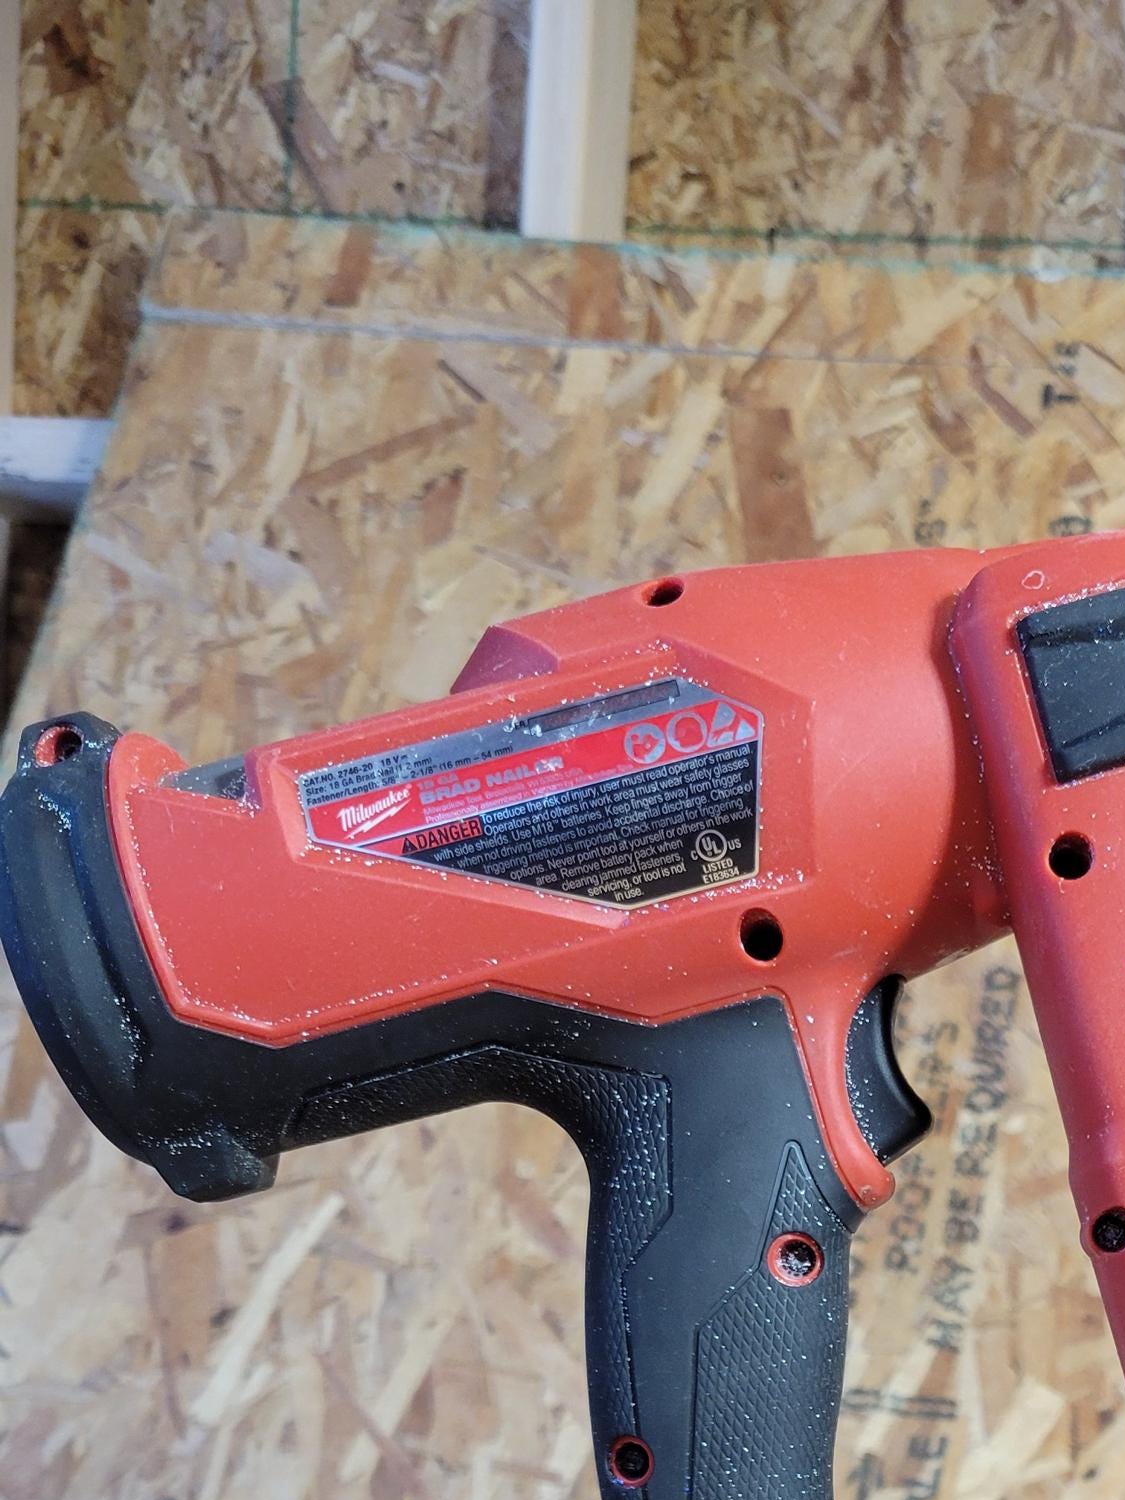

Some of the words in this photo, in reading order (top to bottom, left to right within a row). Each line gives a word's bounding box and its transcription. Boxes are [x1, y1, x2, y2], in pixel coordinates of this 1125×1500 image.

[305, 784, 327, 796] Size:
[329, 781, 340, 790] 18
[341, 777, 354, 786] GA
[395, 762, 411, 773] (12
[413, 756, 432, 767] mm)
[306, 780, 379, 805] Fastener/Length:
[410, 765, 436, 778] 2-1/8"
[439, 761, 453, 771] (16
[454, 758, 471, 766] mm
[480, 751, 491, 759] 54
[494, 745, 513, 756] mm)
[337, 763, 373, 778] 2746-20
[381, 758, 391, 767] 18
[393, 756, 400, 764] V
[335, 787, 410, 832] Milwaukee
[418, 777, 482, 805] BRAD
[480, 814, 493, 824] To
[493, 806, 526, 821] reduce
[526, 801, 542, 812] the
[543, 794, 560, 808] risk
[560, 792, 571, 803] of
[570, 787, 600, 801] injury,
[599, 781, 621, 793] user
[621, 772, 646, 787] must
[646, 766, 667, 780] read
[668, 755, 714, 776] operator's
[483, 817, 531, 837] Operators
[532, 810, 549, 823] and
[550, 805, 579, 818] others
[579, 801, 588, 811] in
[589, 793, 612, 808] work
[613, 790, 634, 802] area
[635, 781, 659, 796] must
[660, 777, 683, 789] wear
[684, 768, 714, 783] safety
[713, 759, 750, 778] glasses
[415, 818, 481, 849] DANGER
[434, 848, 454, 862] with
[454, 844, 474, 856] side
[511, 830, 532, 841] Use
[605, 804, 631, 817] Keep
[630, 795, 663, 810] fingers
[664, 789, 690, 801] away
[689, 783, 712, 794] from
[711, 774, 743, 789] trigger
[457, 855, 485, 868] when
[485, 848, 500, 861] not
[500, 843, 533, 857] driving
[532, 831, 576, 848] fasteners
[576, 827, 586, 837] to
[587, 819, 613, 834] avoid
[614, 806, 660, 827] accidental
[660, 796, 710, 814] discharge.
[710, 786, 744, 801] Choice
[744, 781, 754, 792] of
[483, 856, 529, 874] triggering
[528, 844, 564, 862] method
[564, 843, 573, 853] is
[620, 821, 651, 838] Check
[651, 812, 685, 829] manual
[685, 810, 698, 820] for
[699, 799, 744, 816] triggering
[548, 856, 576, 870] Never
[577, 847, 601, 865] point
[600, 843, 617, 856] tool
[619, 840, 628, 851] at
[629, 830, 665, 851] yourself
[665, 830, 676, 838] or
[676, 822, 706, 835] others
[705, 818, 715, 827] in
[715, 814, 730, 825] the
[730, 806, 753, 821] work
[560, 862, 600, 879] Remove
[600, 854, 634, 868] battery
[634, 845, 657, 862] pack
[657, 840, 683, 853] when
[702, 857, 733, 874] LISTED
[726, 839, 742, 851] US
[561, 876, 600, 892] clearing
[599, 863, 637, 884] jammed
[637, 854, 684, 872] fasteners,
[587, 879, 633, 896] servicing,
[632, 876, 643, 884] or
[642, 868, 662, 882] tool
[661, 867, 670, 877] is
[671, 862, 686, 874] not
[702, 865, 739, 884] E183634
[614, 892, 624, 902] in
[624, 888, 644, 899] use.
[953, 965, 1021, 1178] REQUIRED
[944, 1188, 985, 1245] BE
[925, 1256, 974, 1352] MAY
